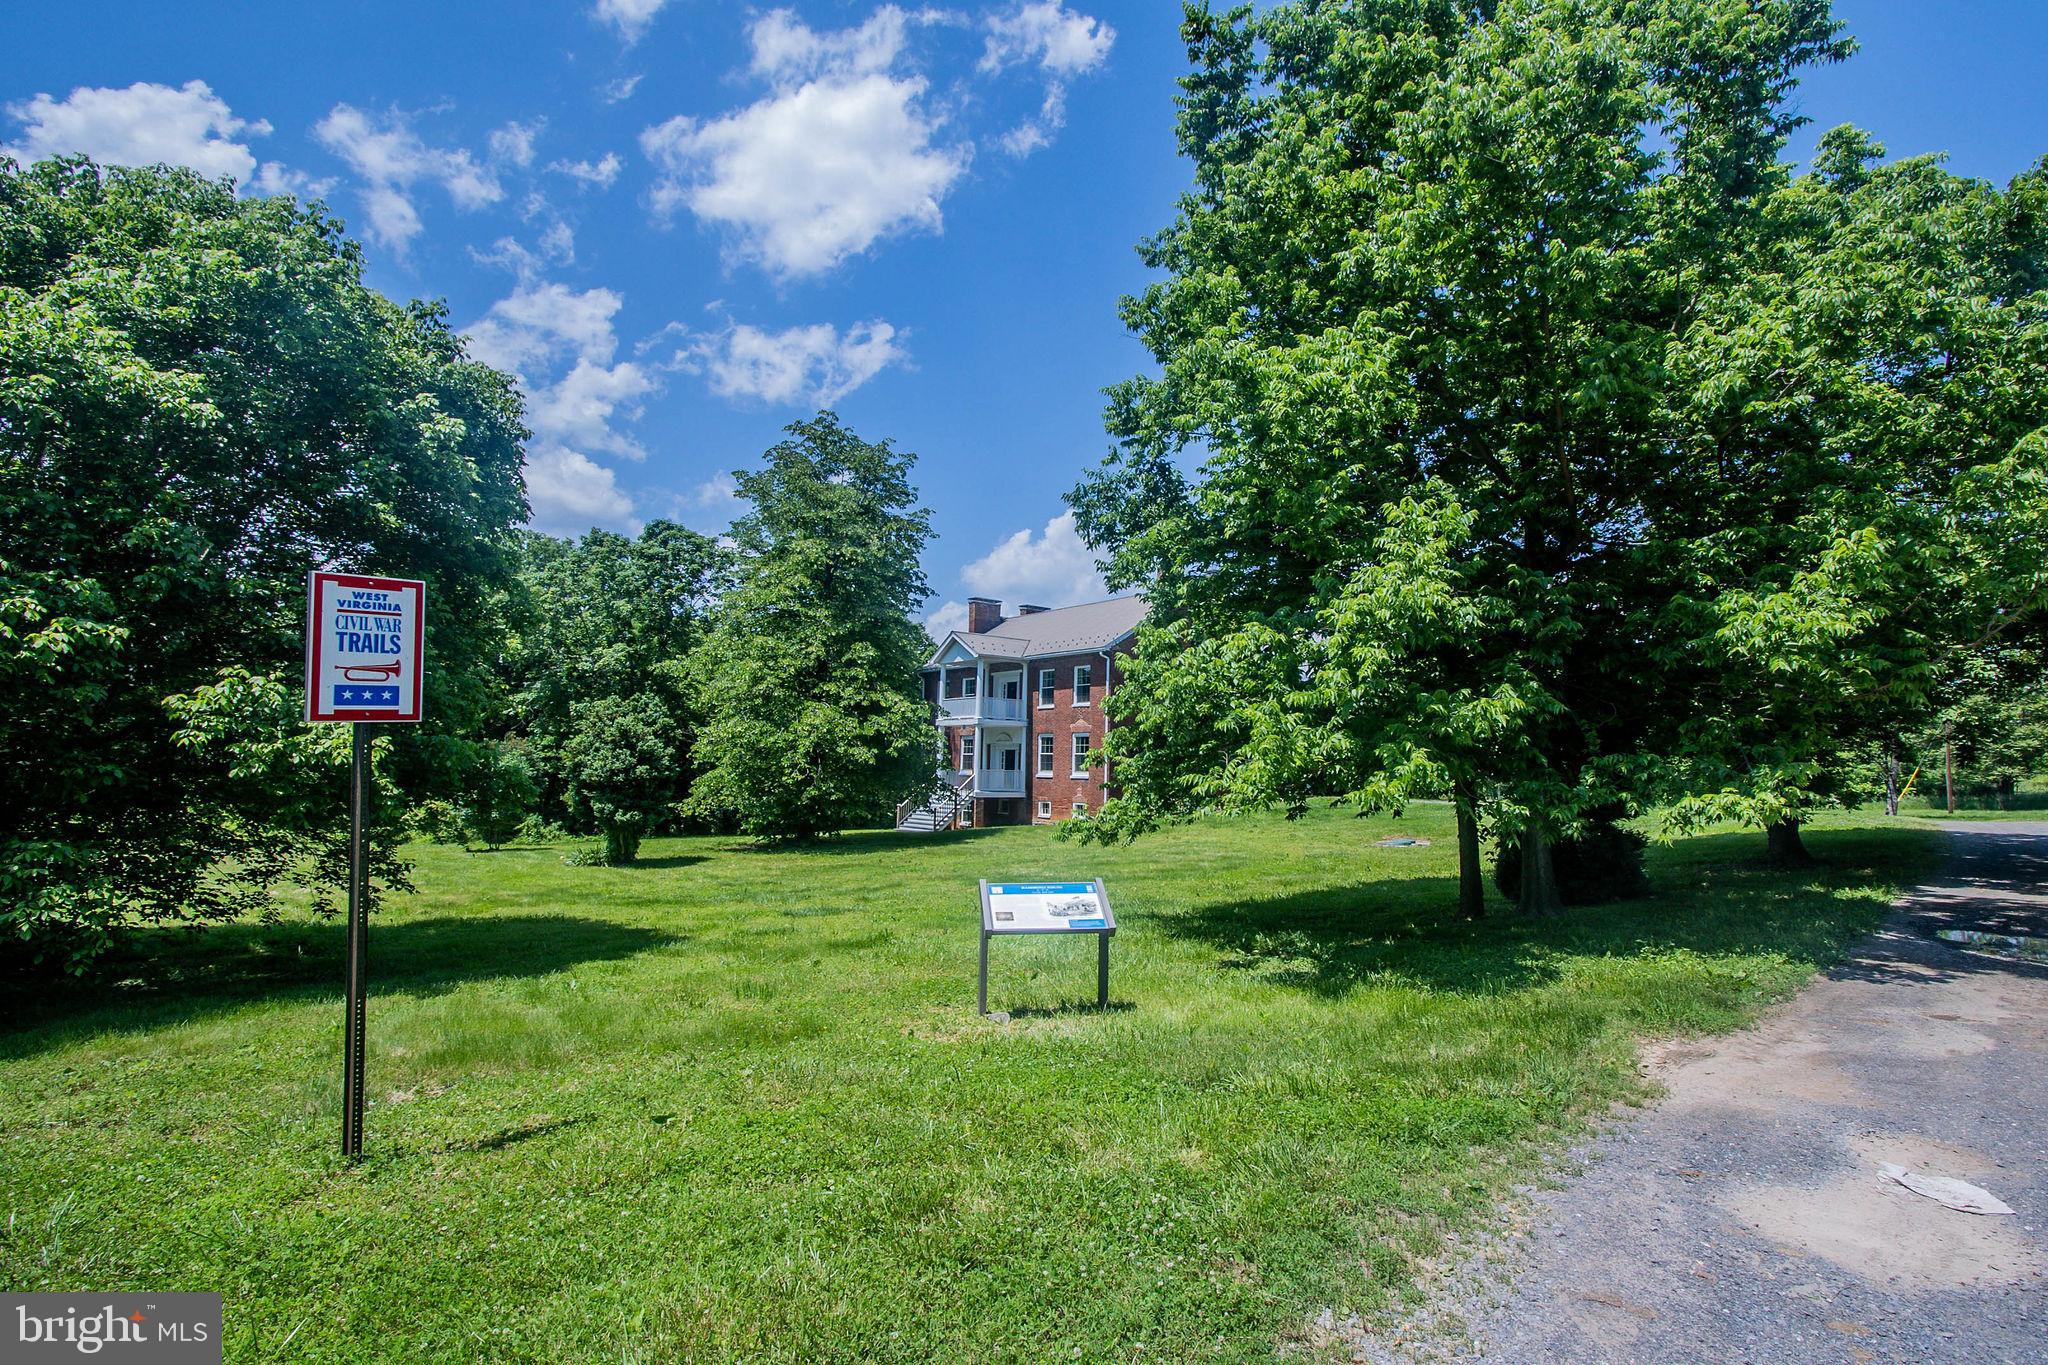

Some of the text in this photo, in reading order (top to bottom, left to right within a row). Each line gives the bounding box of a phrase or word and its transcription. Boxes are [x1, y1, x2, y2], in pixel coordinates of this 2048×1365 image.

[351, 591, 389, 601] WEST
[336, 599, 402, 611] VIRGINIA
[335, 615, 402, 633] CIVIL WAR
[335, 631, 402, 654] TRAILS
